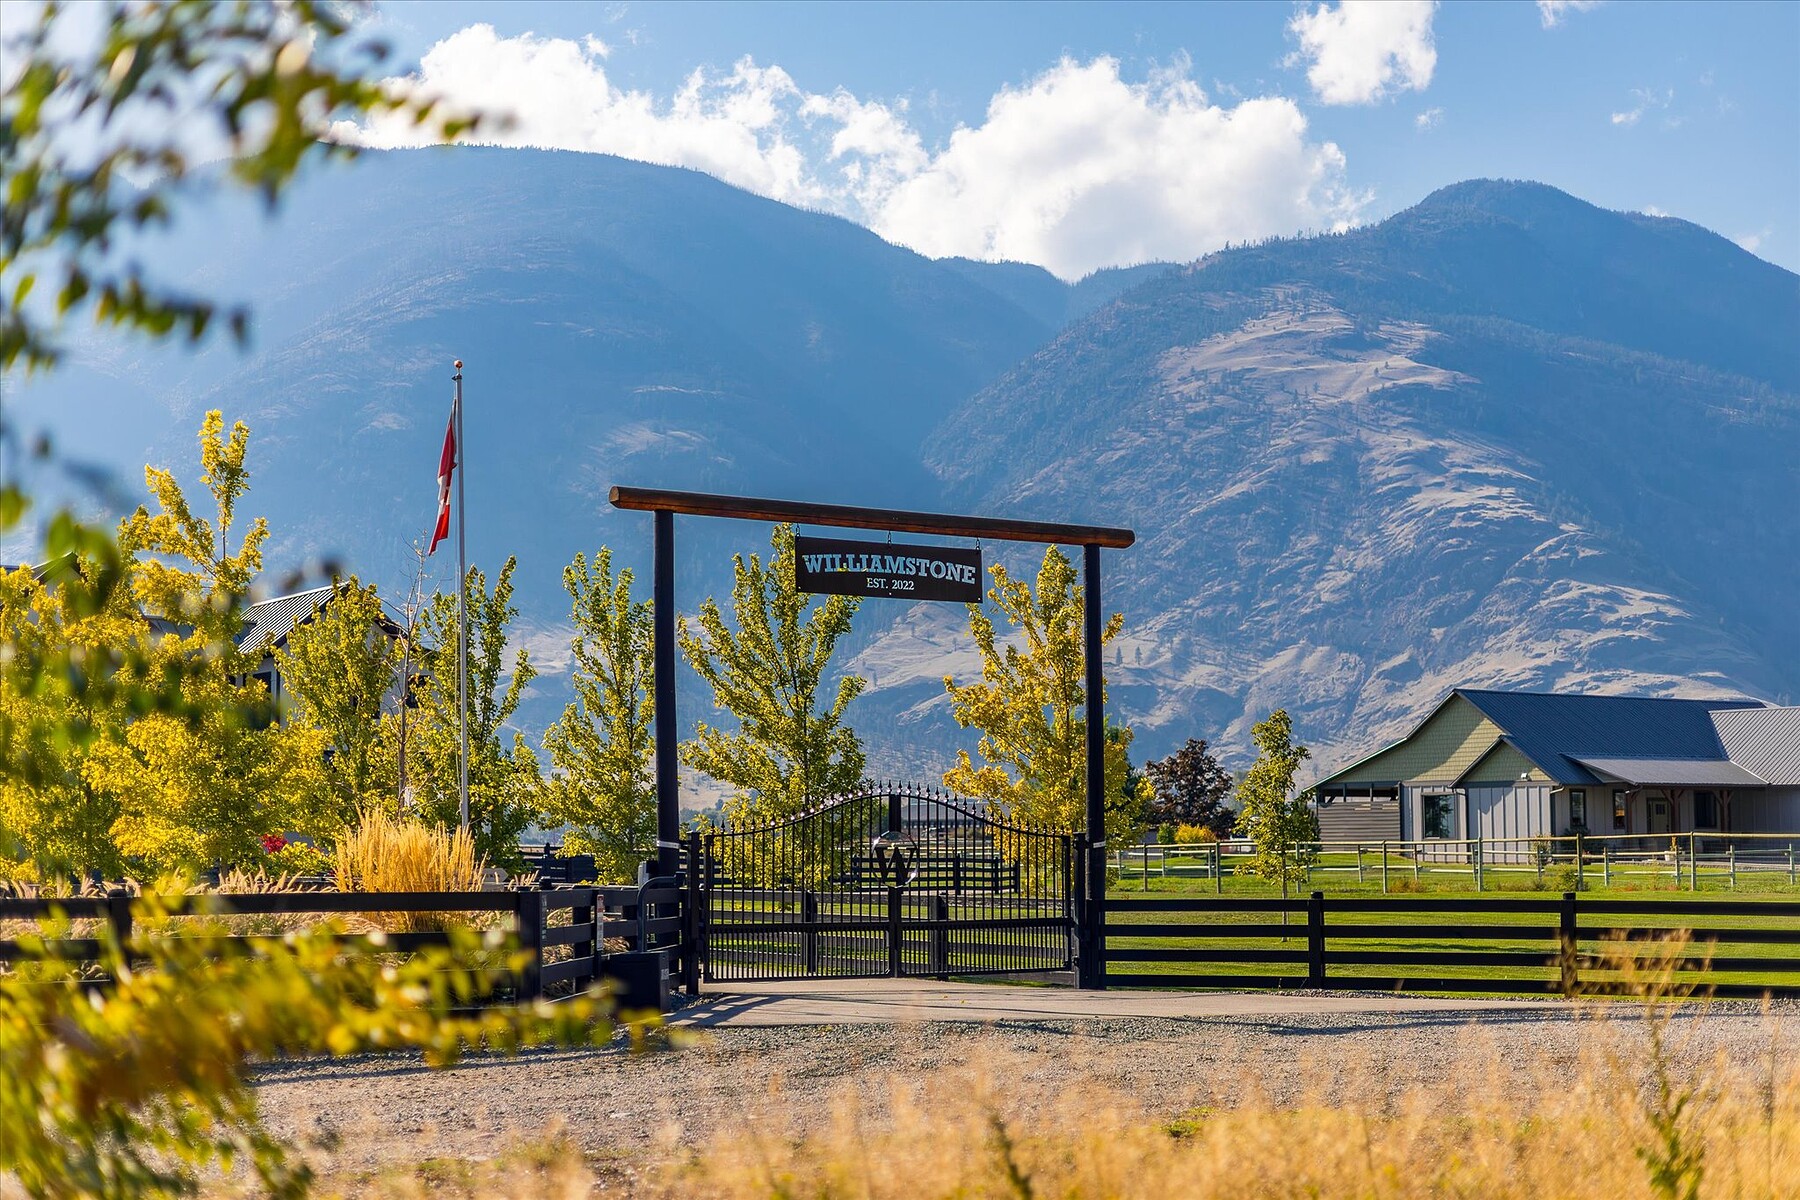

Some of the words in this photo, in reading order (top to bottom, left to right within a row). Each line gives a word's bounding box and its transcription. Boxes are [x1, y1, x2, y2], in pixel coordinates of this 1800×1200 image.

[802, 554, 976, 584] WILLIAMSTONE
[866, 577, 888, 589] EST.
[891, 579, 915, 591] 2022
[874, 845, 918, 886] W
